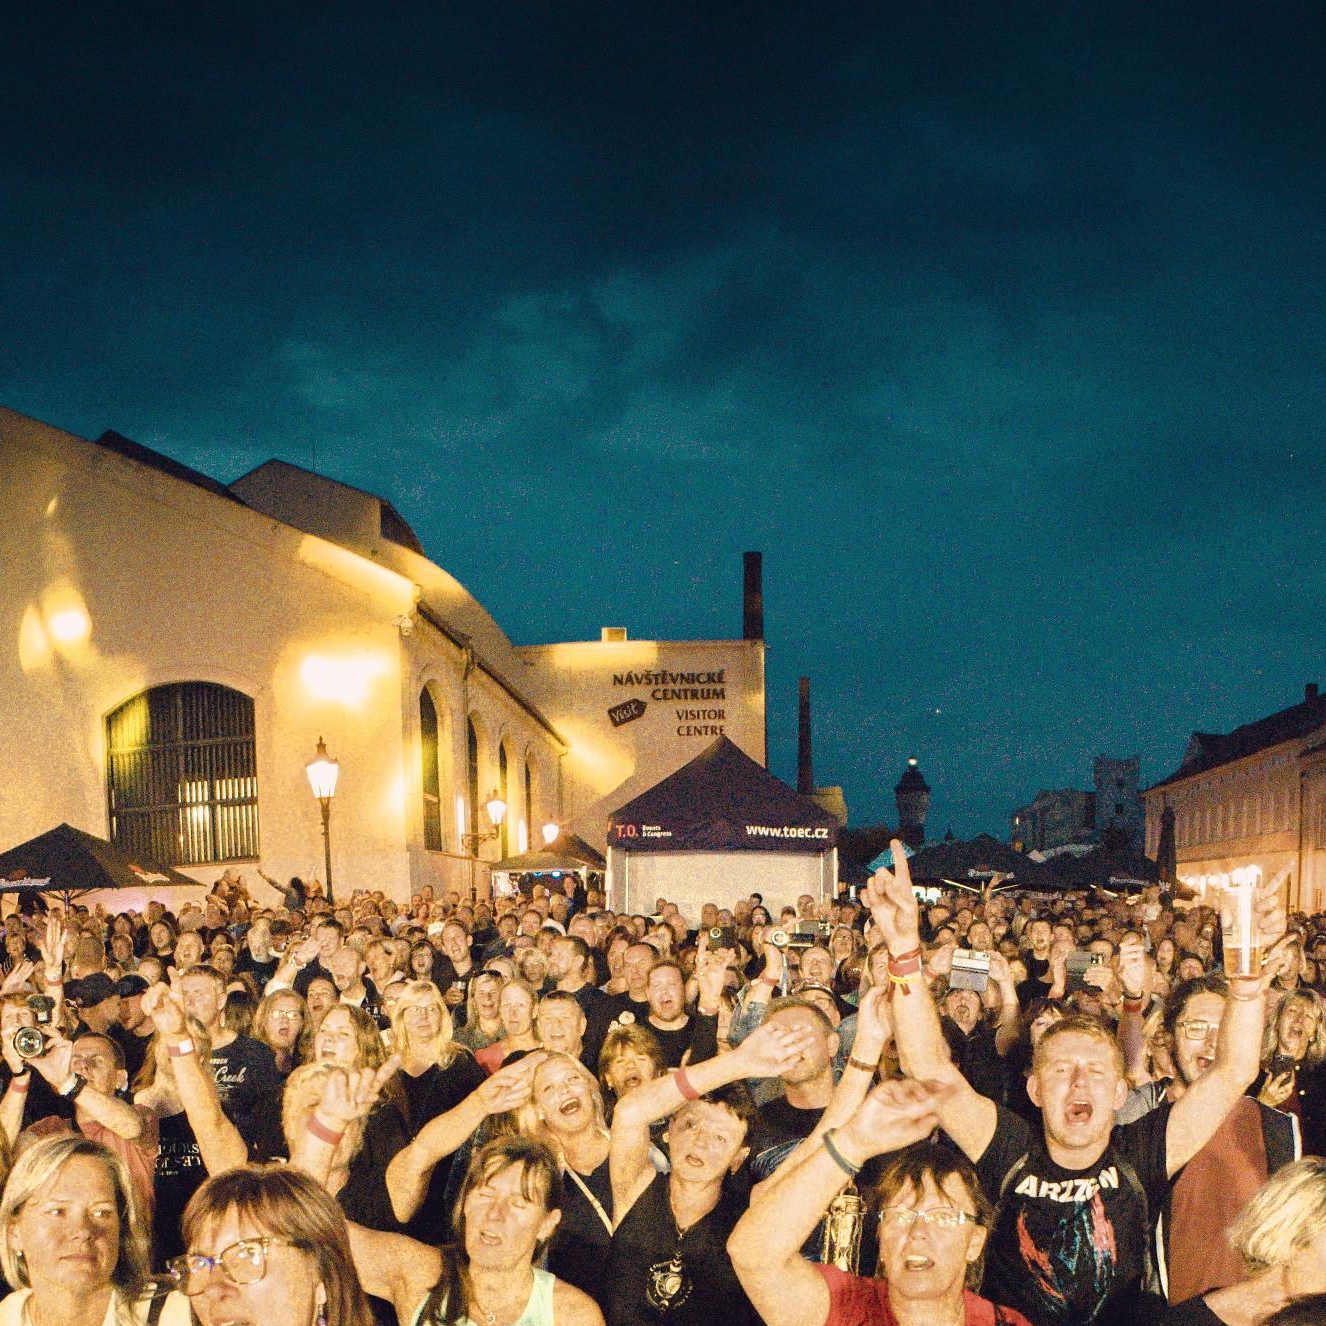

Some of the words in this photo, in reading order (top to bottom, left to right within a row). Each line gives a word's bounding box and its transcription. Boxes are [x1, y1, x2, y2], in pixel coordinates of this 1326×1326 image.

[613, 669, 725, 685] NÁVŠTĚVNICKÉ
[651, 688, 725, 700] CENTRUM
[676, 709, 725, 720] VISITOR
[677, 725, 726, 736] CENTRE
[746, 825, 828, 839] www.toec.cz
